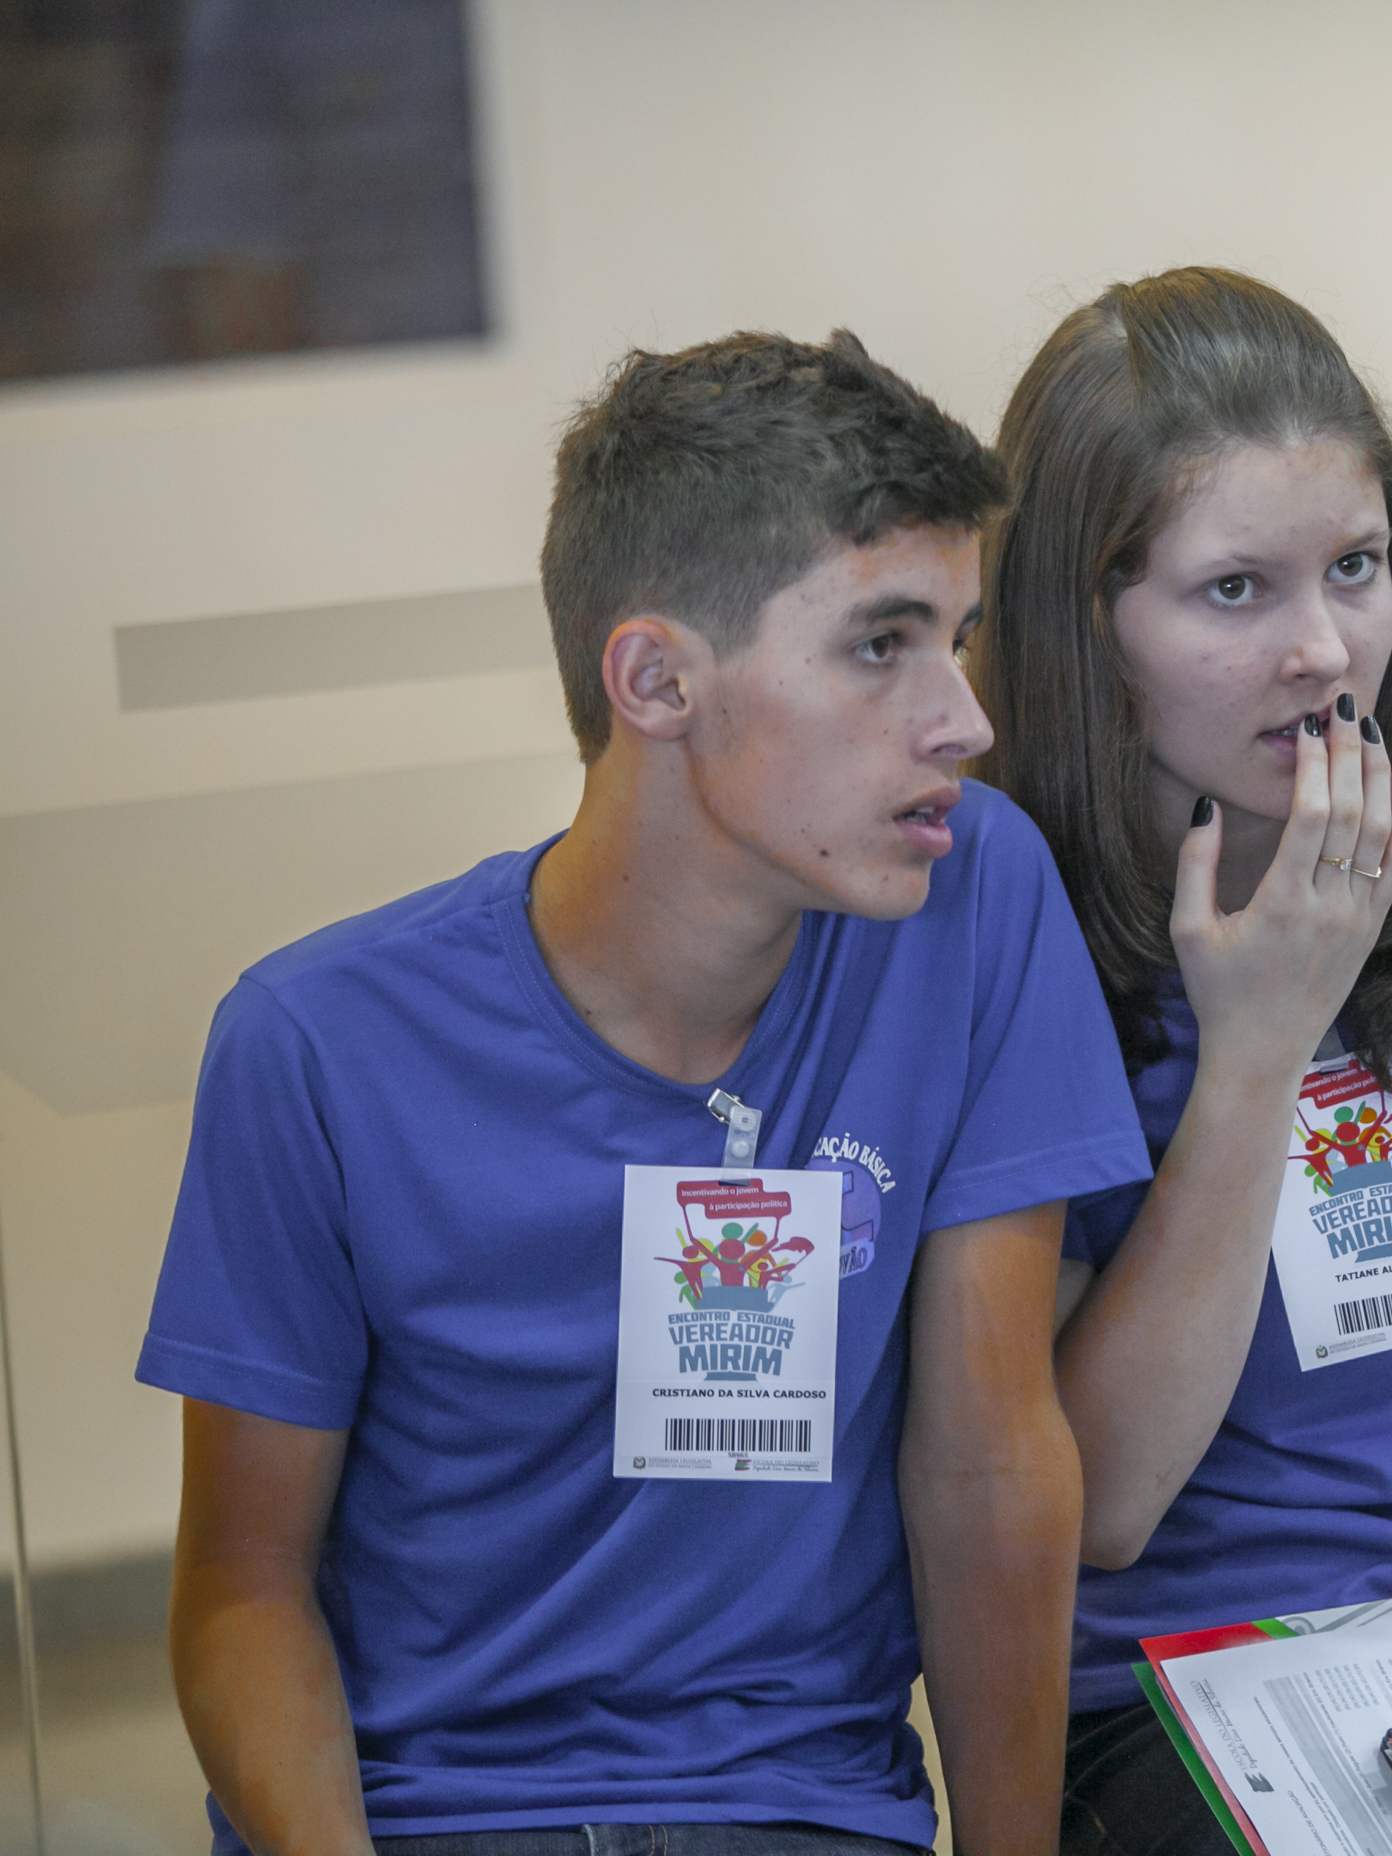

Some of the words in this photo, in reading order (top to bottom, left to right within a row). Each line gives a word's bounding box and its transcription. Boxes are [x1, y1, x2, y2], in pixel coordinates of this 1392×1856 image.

[1300, 1077, 1331, 1091] entivando
[1337, 1069, 1358, 1080] jovem
[1322, 1082, 1362, 1100] participação
[813, 1133, 859, 1163] CAÇÃO
[859, 1147, 896, 1193] BÁSICA
[682, 1188, 728, 1197] Incentivando
[736, 1187, 759, 1196] jovem
[1309, 1190, 1364, 1216] ENCONTRO
[715, 1201, 759, 1211] participação
[1335, 1268, 1379, 1282] TATIANE
[668, 1311, 730, 1324] ENCONTRO
[737, 1312, 795, 1329] ESTADUAL
[669, 1323, 793, 1349] VEREADOR
[679, 1344, 782, 1376] MIRIM
[652, 1388, 714, 1397] CRISTIANO
[718, 1389, 734, 1397] DA
[737, 1389, 770, 1398] SILVA
[773, 1390, 827, 1399] CARDOSO
[1189, 1679, 1222, 1727] LEGISLATIVO
[1217, 1728, 1230, 1741] DO
[1225, 1742, 1247, 1770] ESCOLA
[1285, 1789, 1309, 1819] AVALIAÇÃO
[1304, 1819, 1314, 1827] DE
[1309, 1828, 1331, 1855] TIONÁRIO
